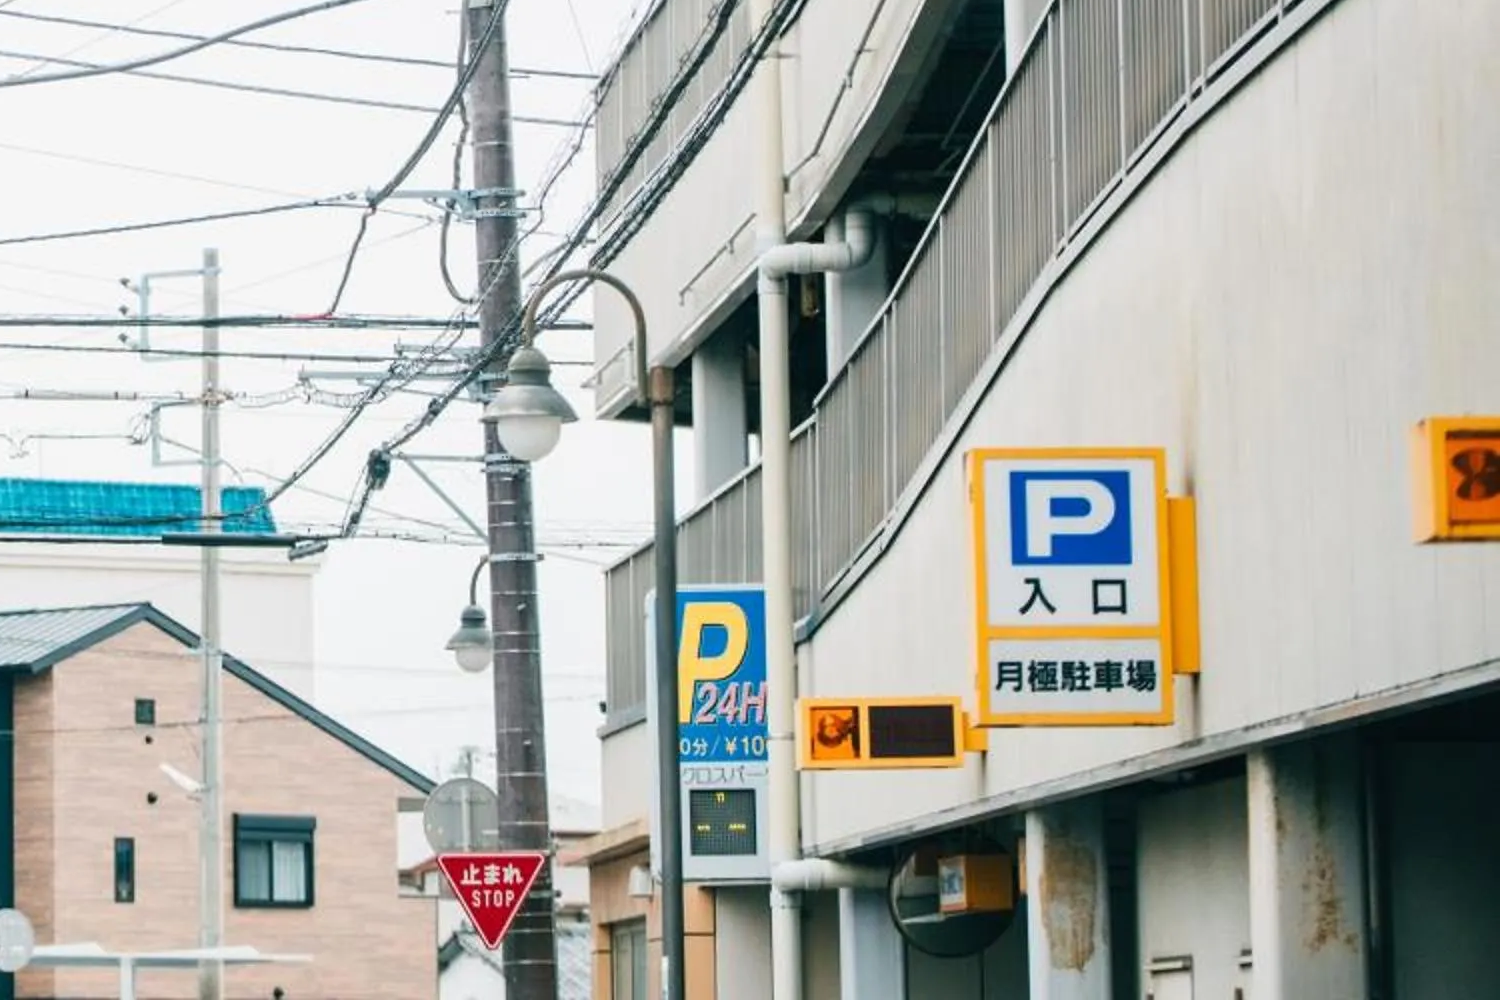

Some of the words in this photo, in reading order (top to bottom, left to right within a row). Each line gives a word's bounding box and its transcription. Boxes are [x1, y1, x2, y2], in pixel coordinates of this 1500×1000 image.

[1025, 479, 1116, 558] P
[1018, 577, 1128, 616] 入口
[677, 601, 748, 724] P
[995, 659, 1157, 693] 月極駐車場
[695, 681, 768, 724] 24H
[683, 765, 769, 786] クロスパー
[460, 863, 524, 886] 止まれ
[471, 889, 516, 908] STOP
